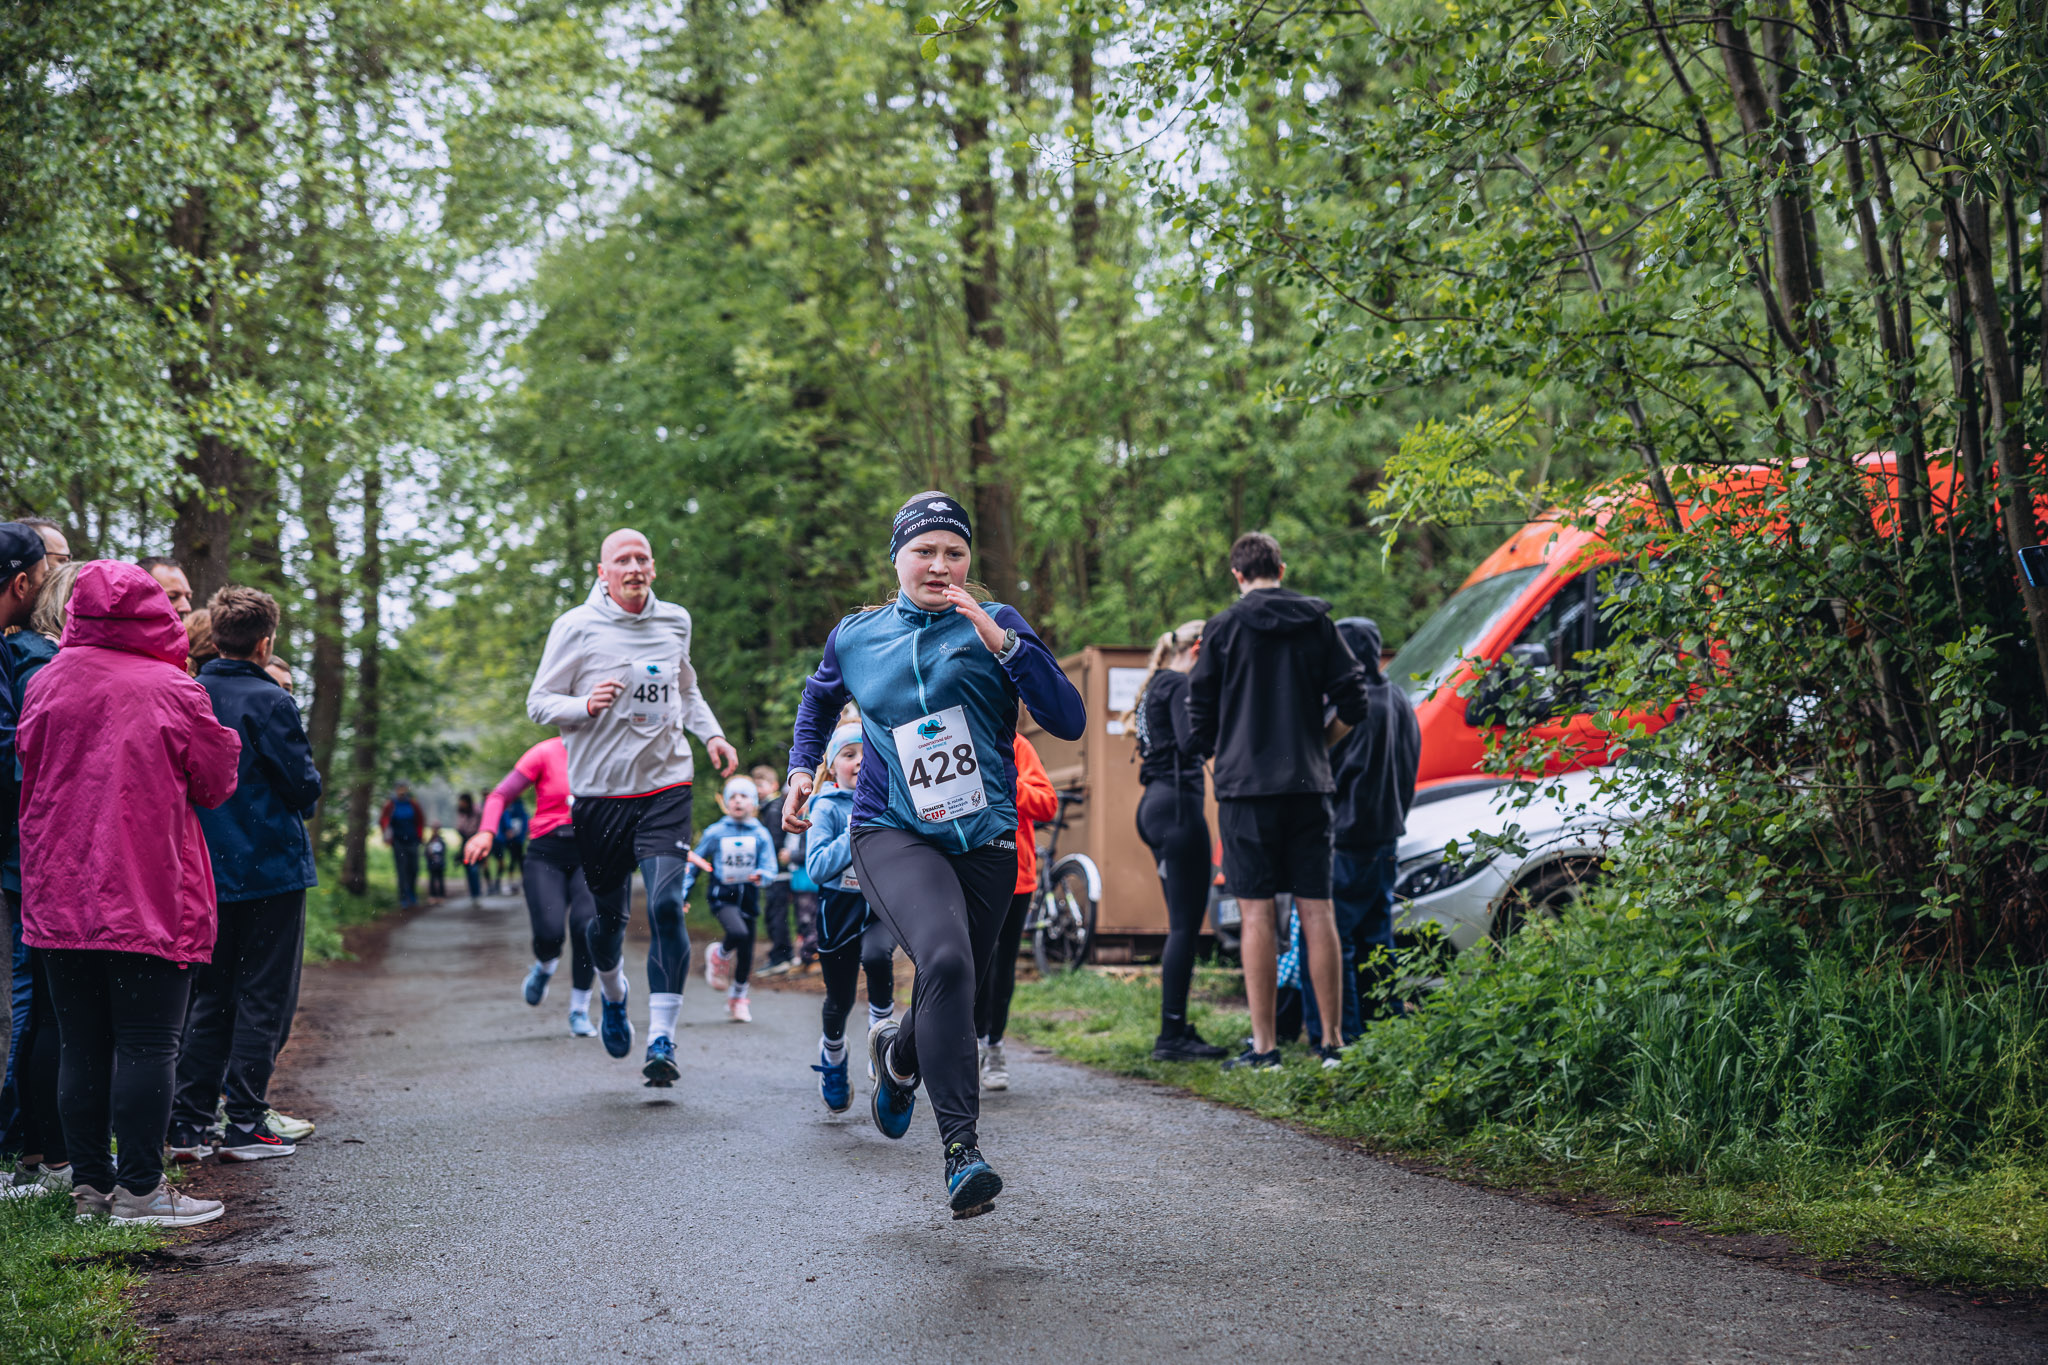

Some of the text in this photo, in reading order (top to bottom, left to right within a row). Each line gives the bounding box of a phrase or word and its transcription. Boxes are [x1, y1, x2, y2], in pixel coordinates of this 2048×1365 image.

[633, 684, 669, 703] 481
[909, 744, 977, 788] 428
[924, 809, 946, 821] CUP
[1000, 840, 1015, 849] PUMA
